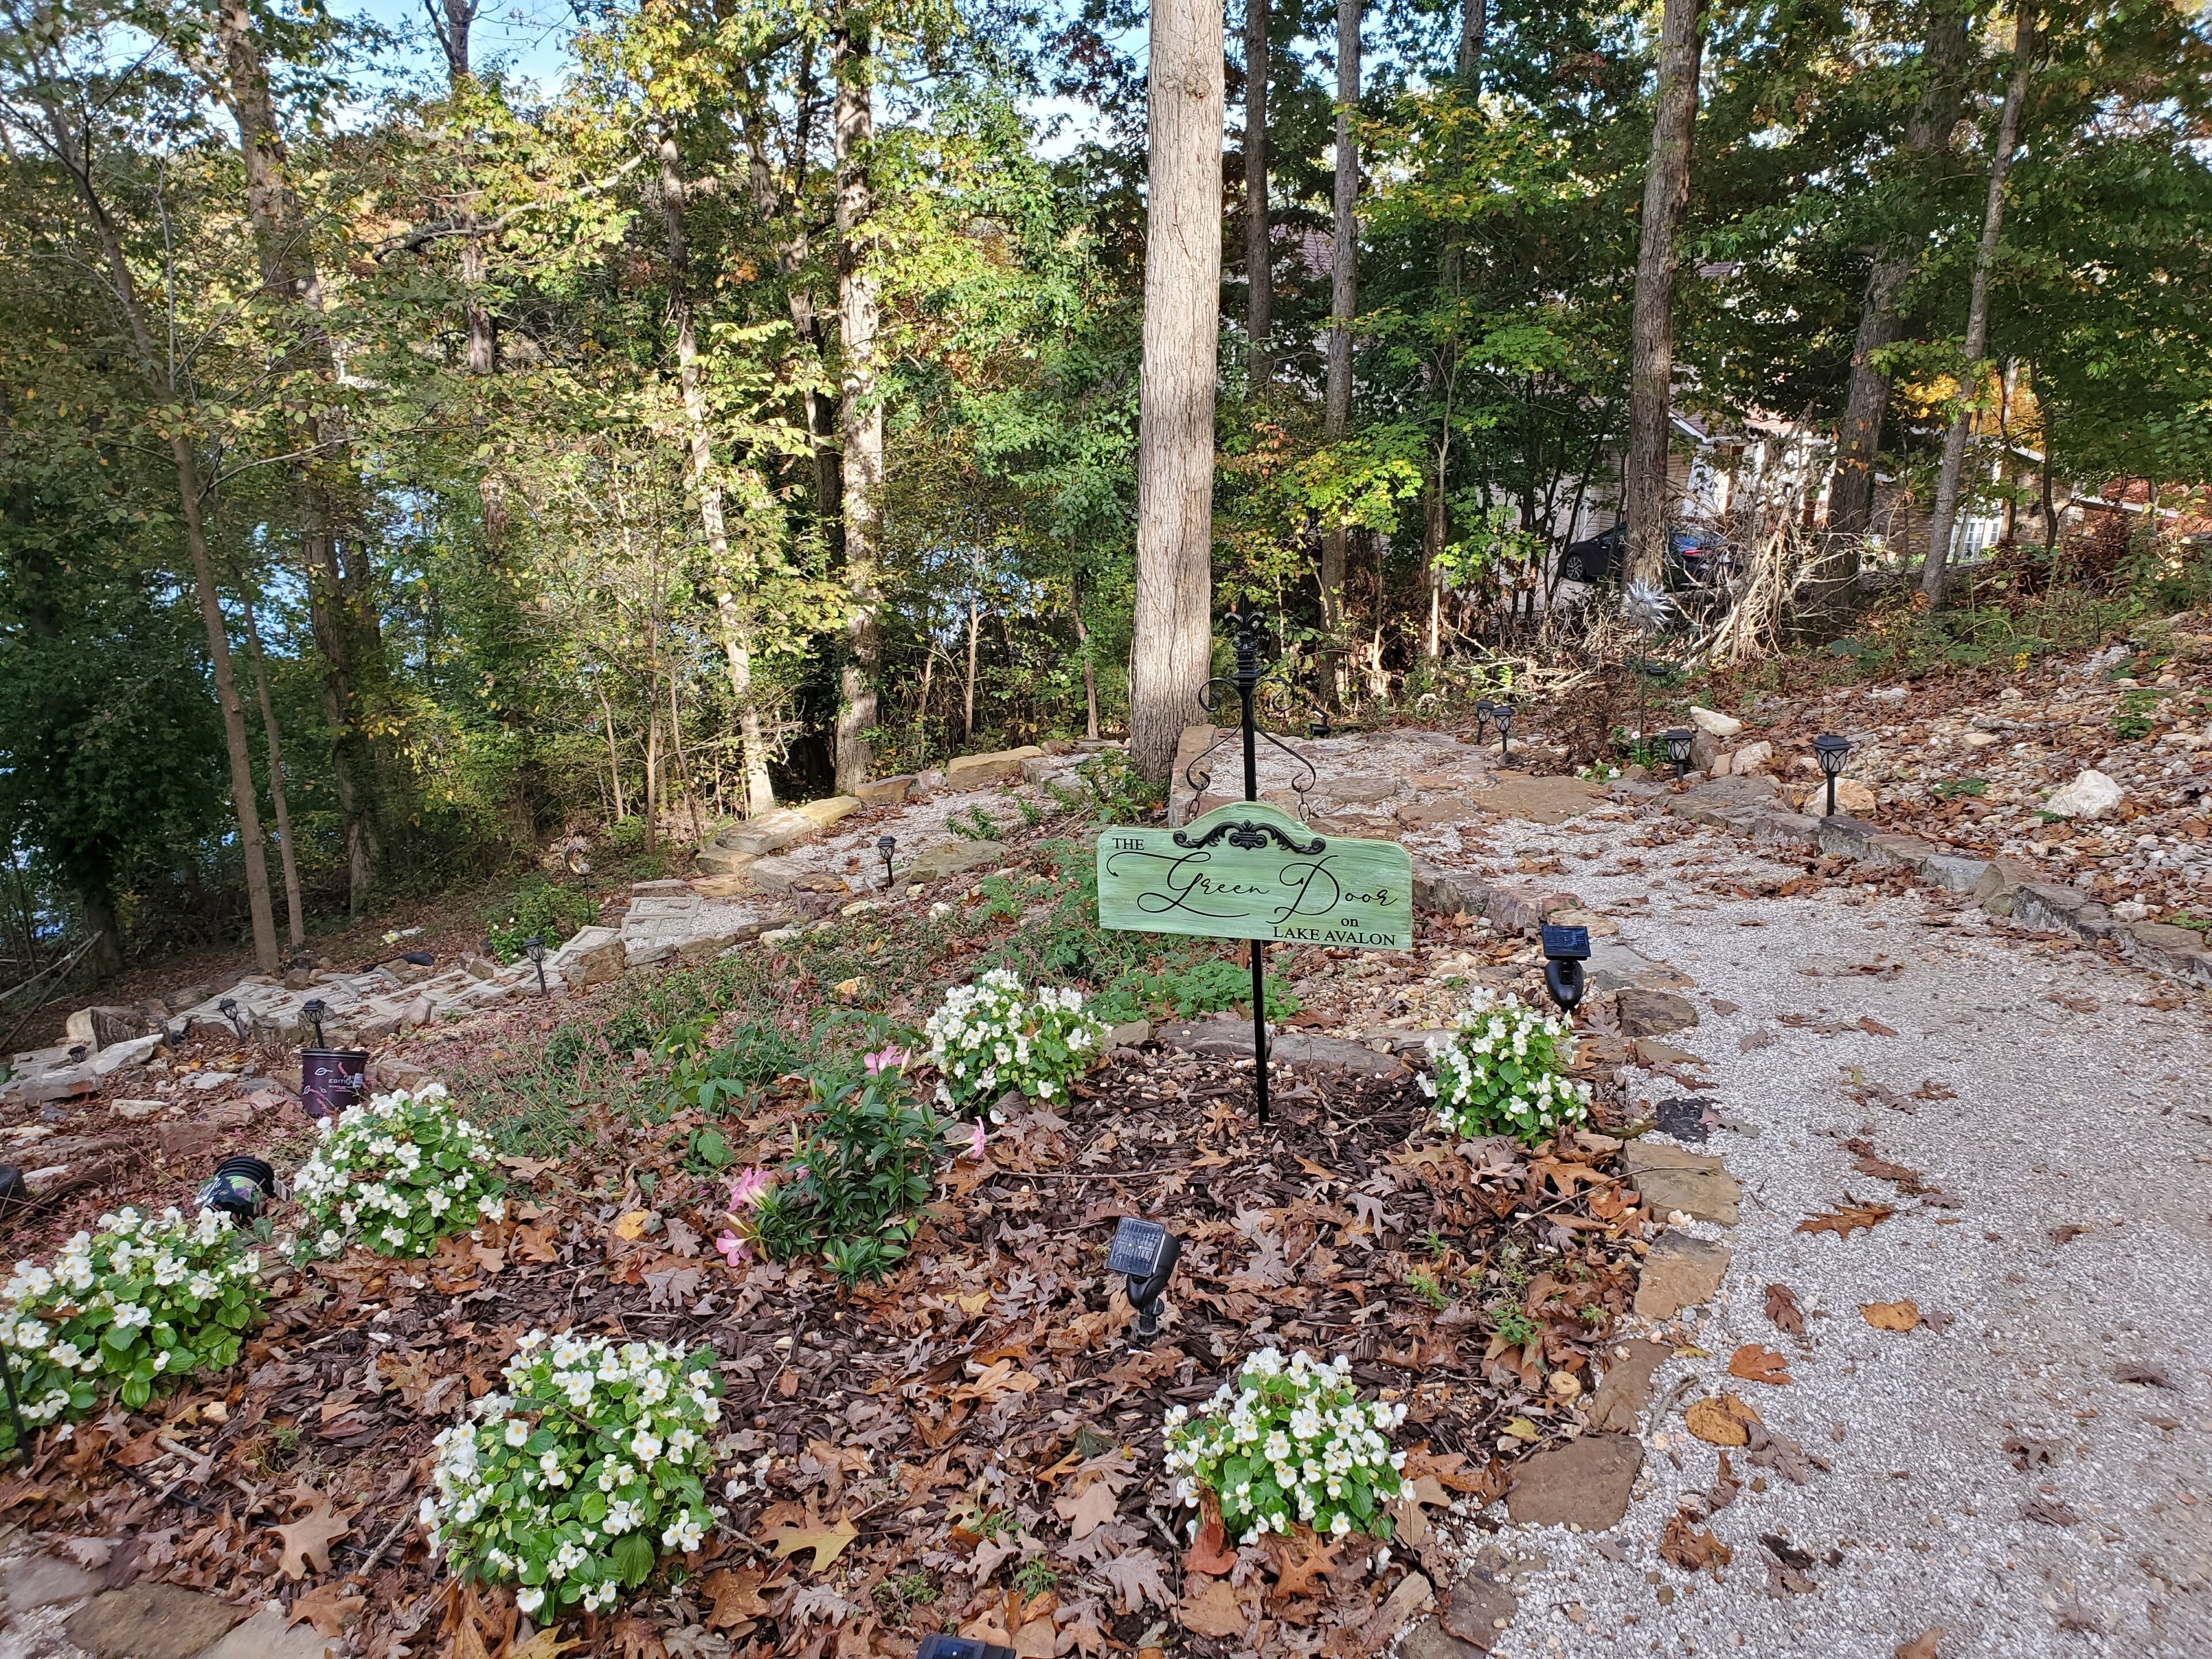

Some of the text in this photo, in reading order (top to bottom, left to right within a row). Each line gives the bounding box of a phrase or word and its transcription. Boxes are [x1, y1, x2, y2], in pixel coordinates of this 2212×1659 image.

[1112, 838, 1145, 850] THE
[1107, 851, 1398, 925] Green Door
[1340, 917, 1359, 927] on
[1273, 926, 1396, 946] LAKE AVALON
